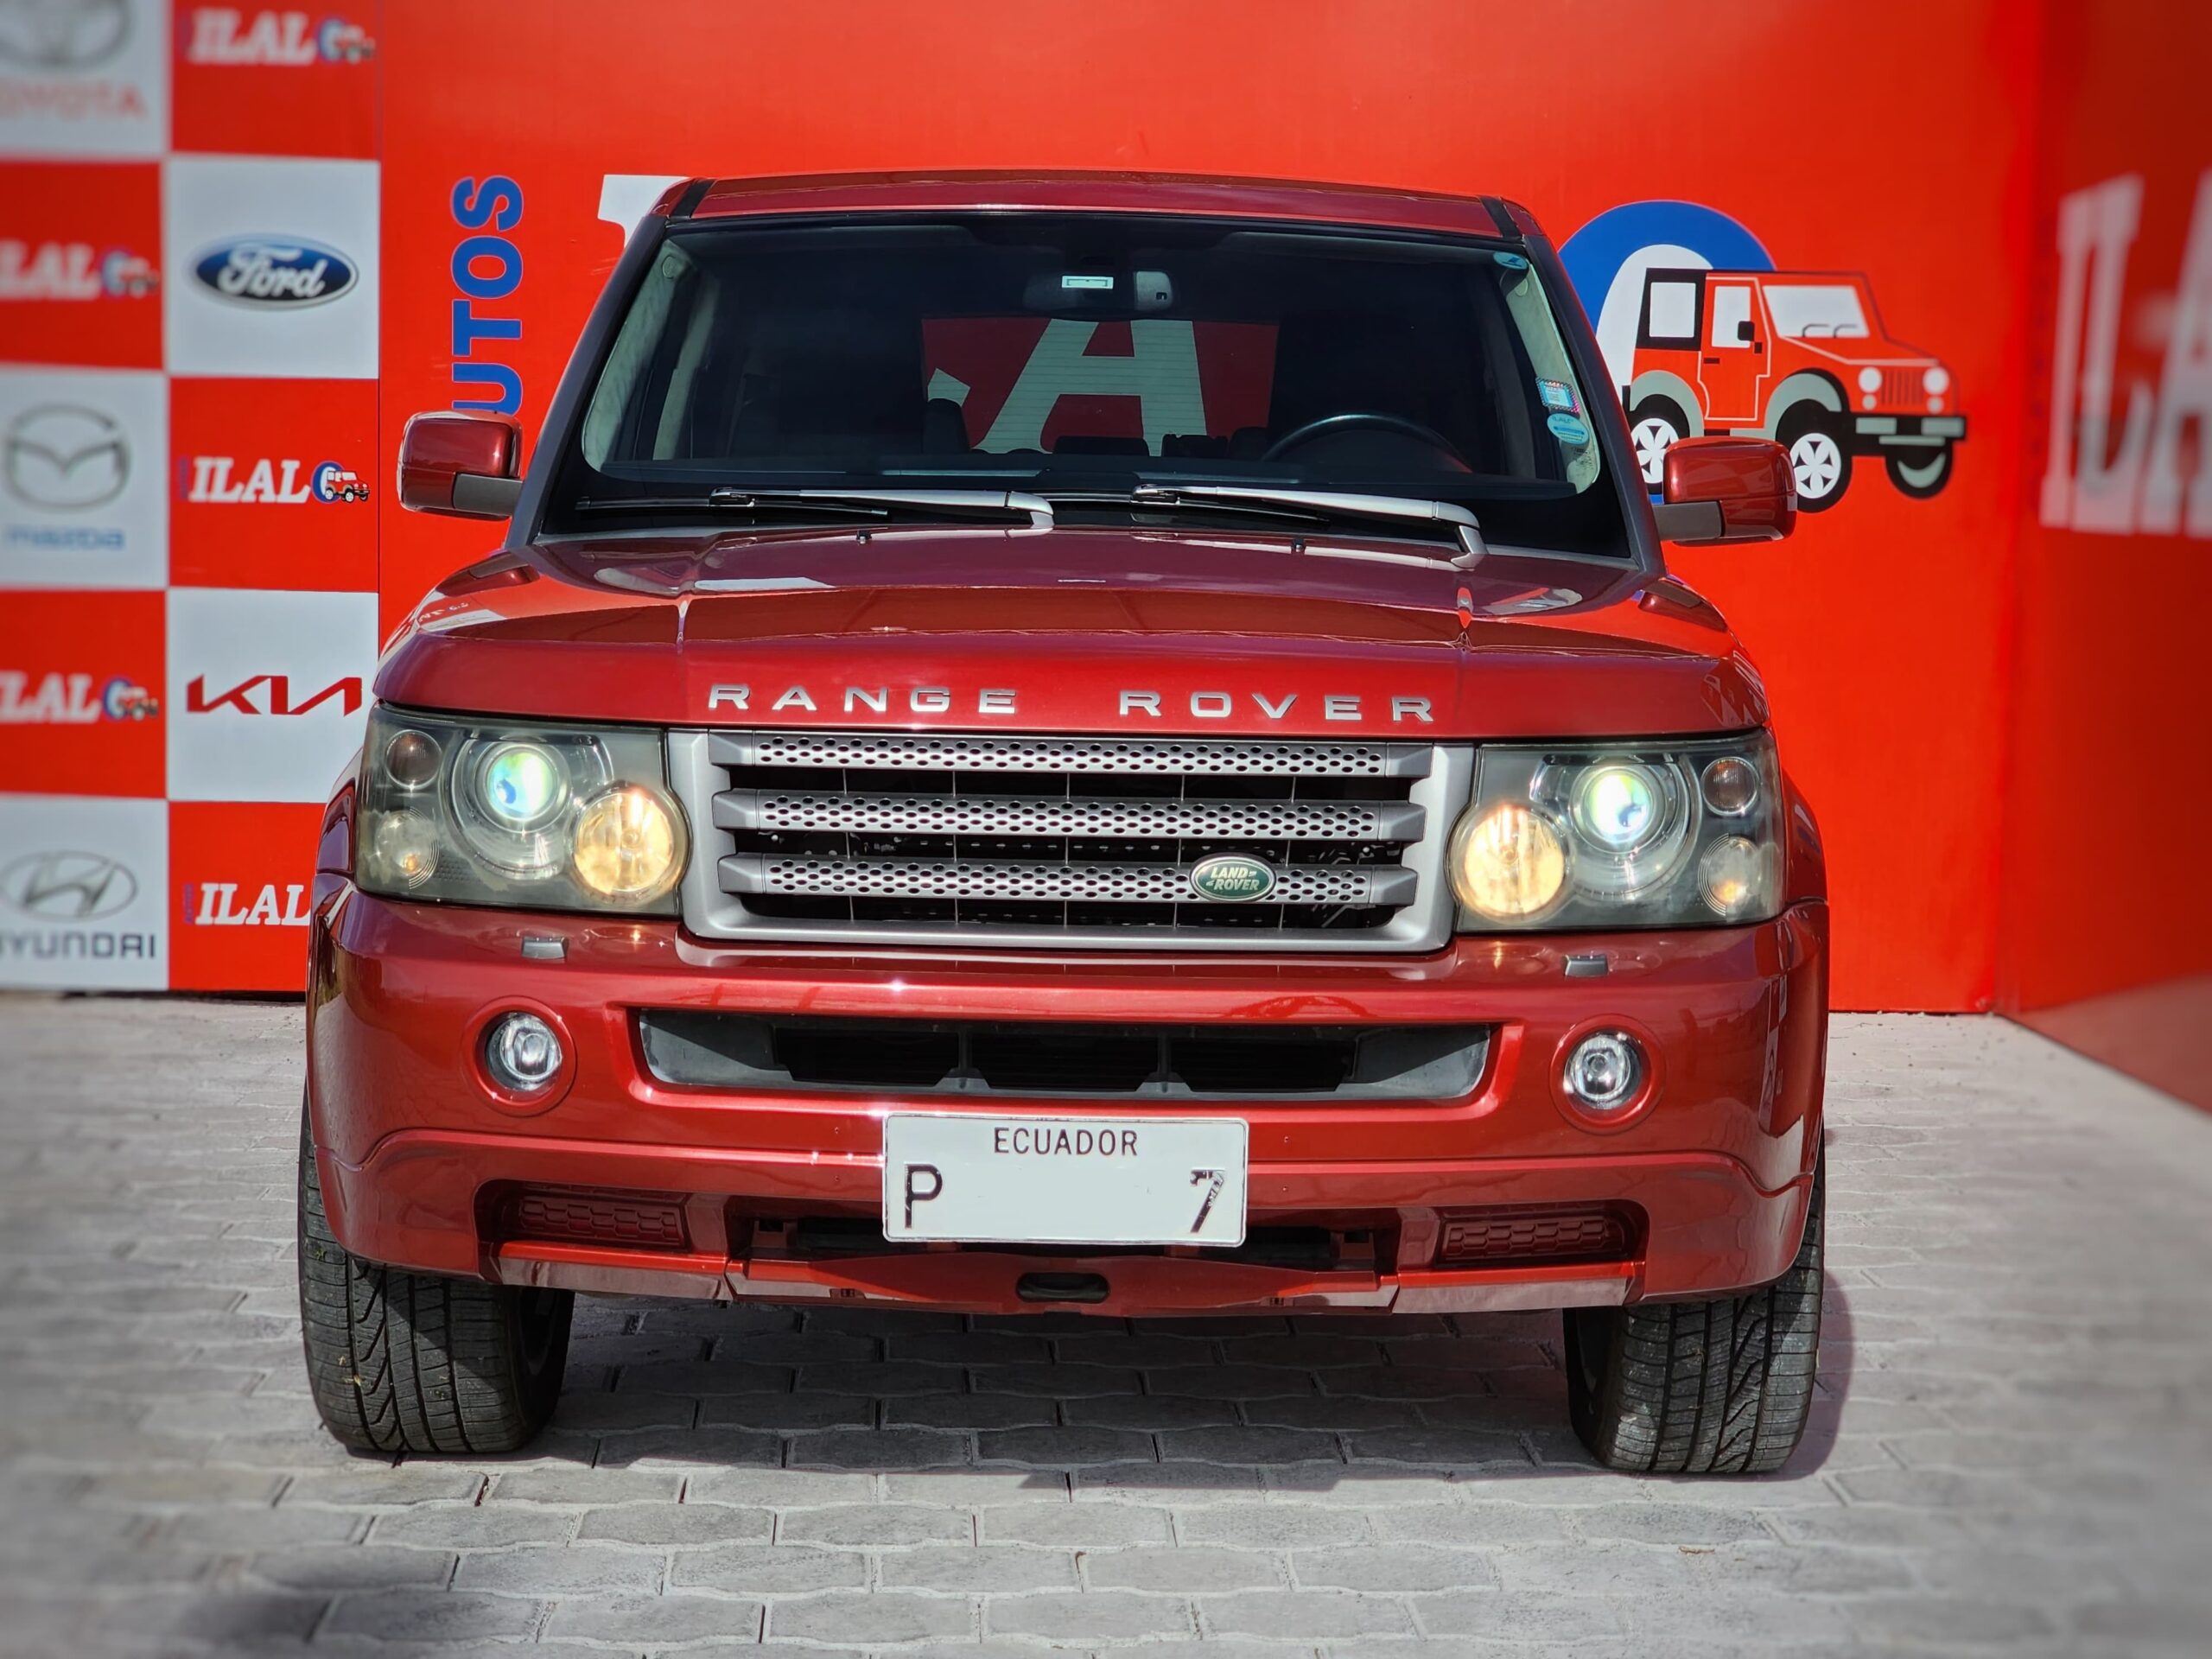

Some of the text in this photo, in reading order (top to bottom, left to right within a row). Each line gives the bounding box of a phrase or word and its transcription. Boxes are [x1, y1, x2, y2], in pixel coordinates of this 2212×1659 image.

[217, 242, 329, 299] Ford
[451, 175, 524, 416] UTOS
[707, 684, 1434, 722] RANGE ROVER
[1210, 866, 1249, 879] LAND
[1213, 879, 1260, 891] ROVER
[0, 930, 156, 959] YUNDAI
[993, 1127, 1139, 1156] ECUADOR
[903, 1162, 944, 1230] P
